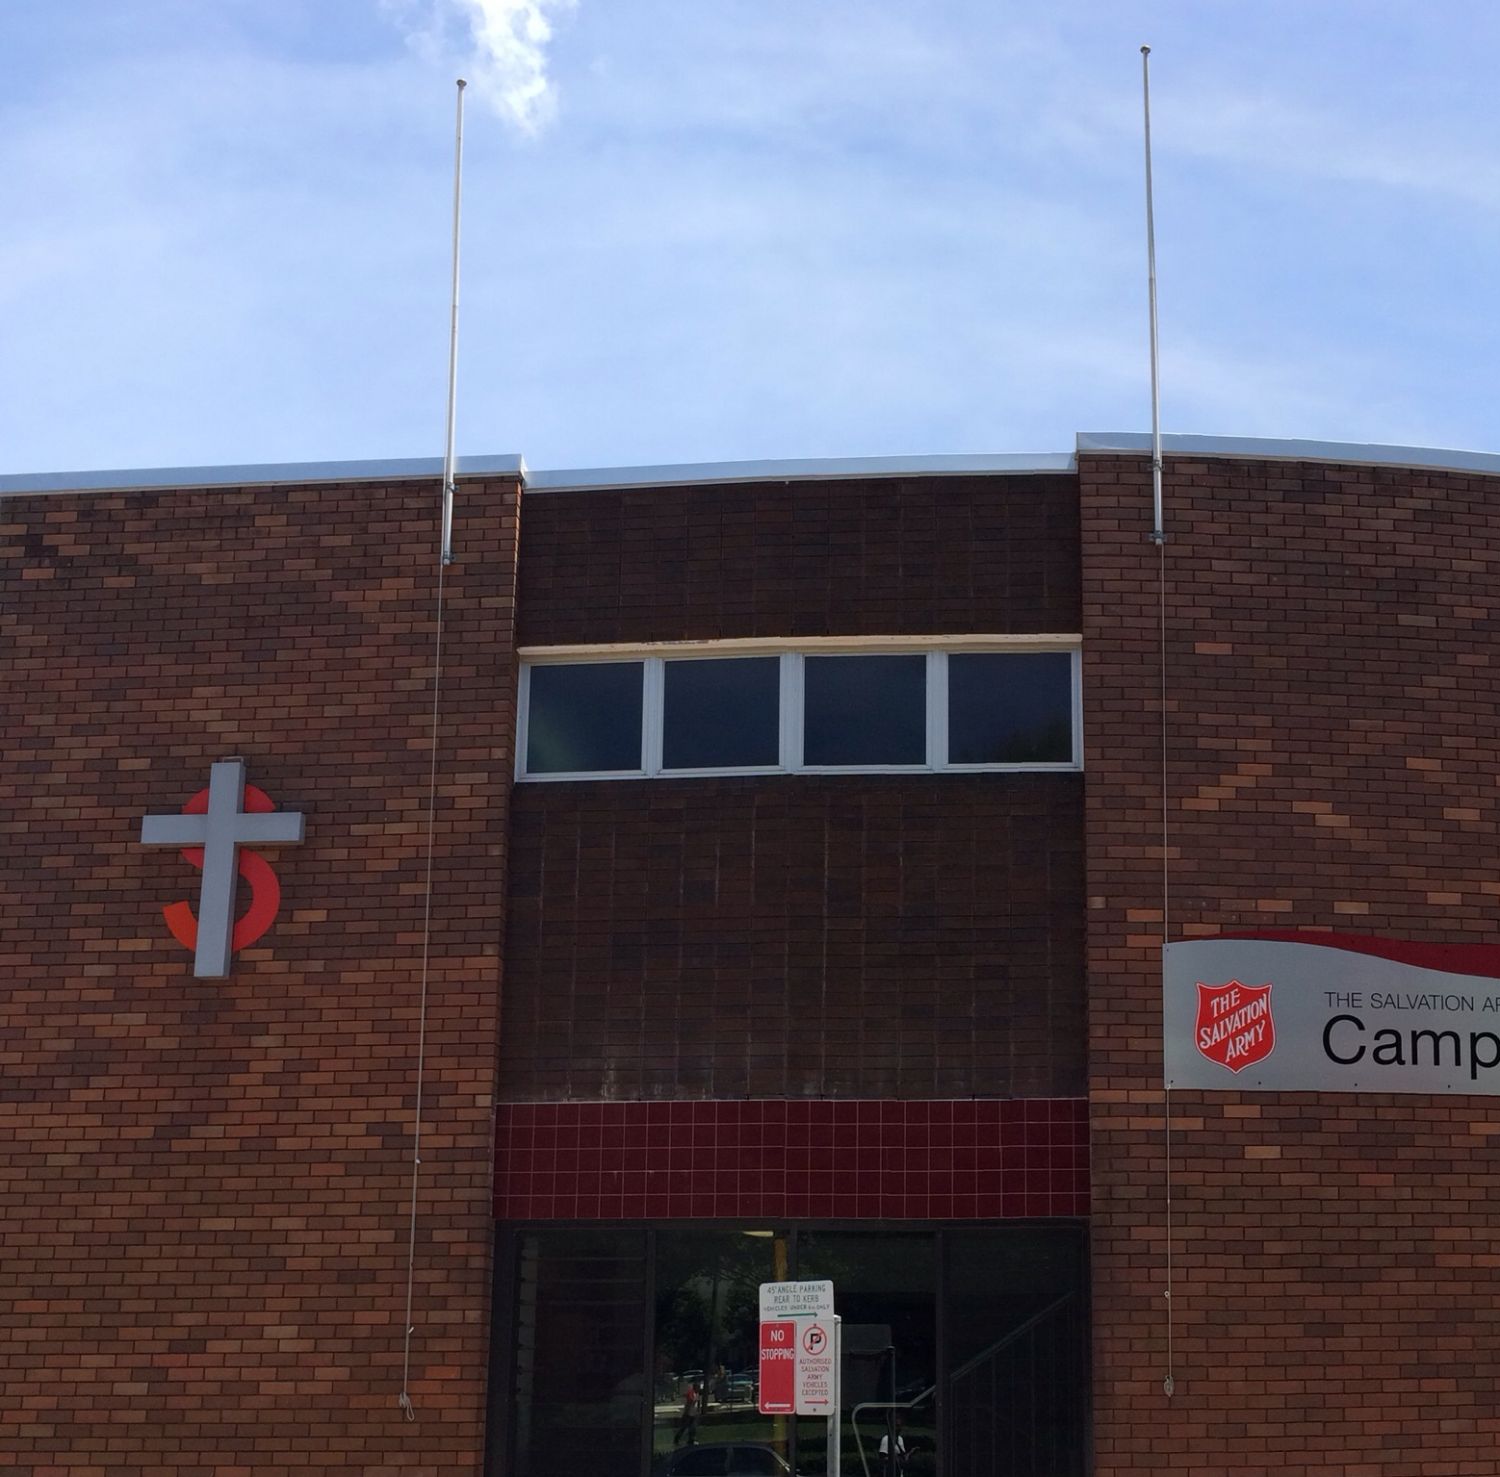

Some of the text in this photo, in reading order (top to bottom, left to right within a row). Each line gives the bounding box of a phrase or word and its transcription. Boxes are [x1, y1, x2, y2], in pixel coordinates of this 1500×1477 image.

[1211, 988, 1240, 1018] THE
[1324, 991, 1363, 1009] THE
[1370, 992, 1475, 1012] SALVATION
[1199, 993, 1267, 1049] SALVATION
[1225, 1020, 1265, 1063] ARMY
[799, 1284, 826, 1293] PARKING
[774, 1294, 819, 1304] REAR TO KERB
[770, 1330, 785, 1342] NO
[761, 1348, 795, 1360] STOPPING
